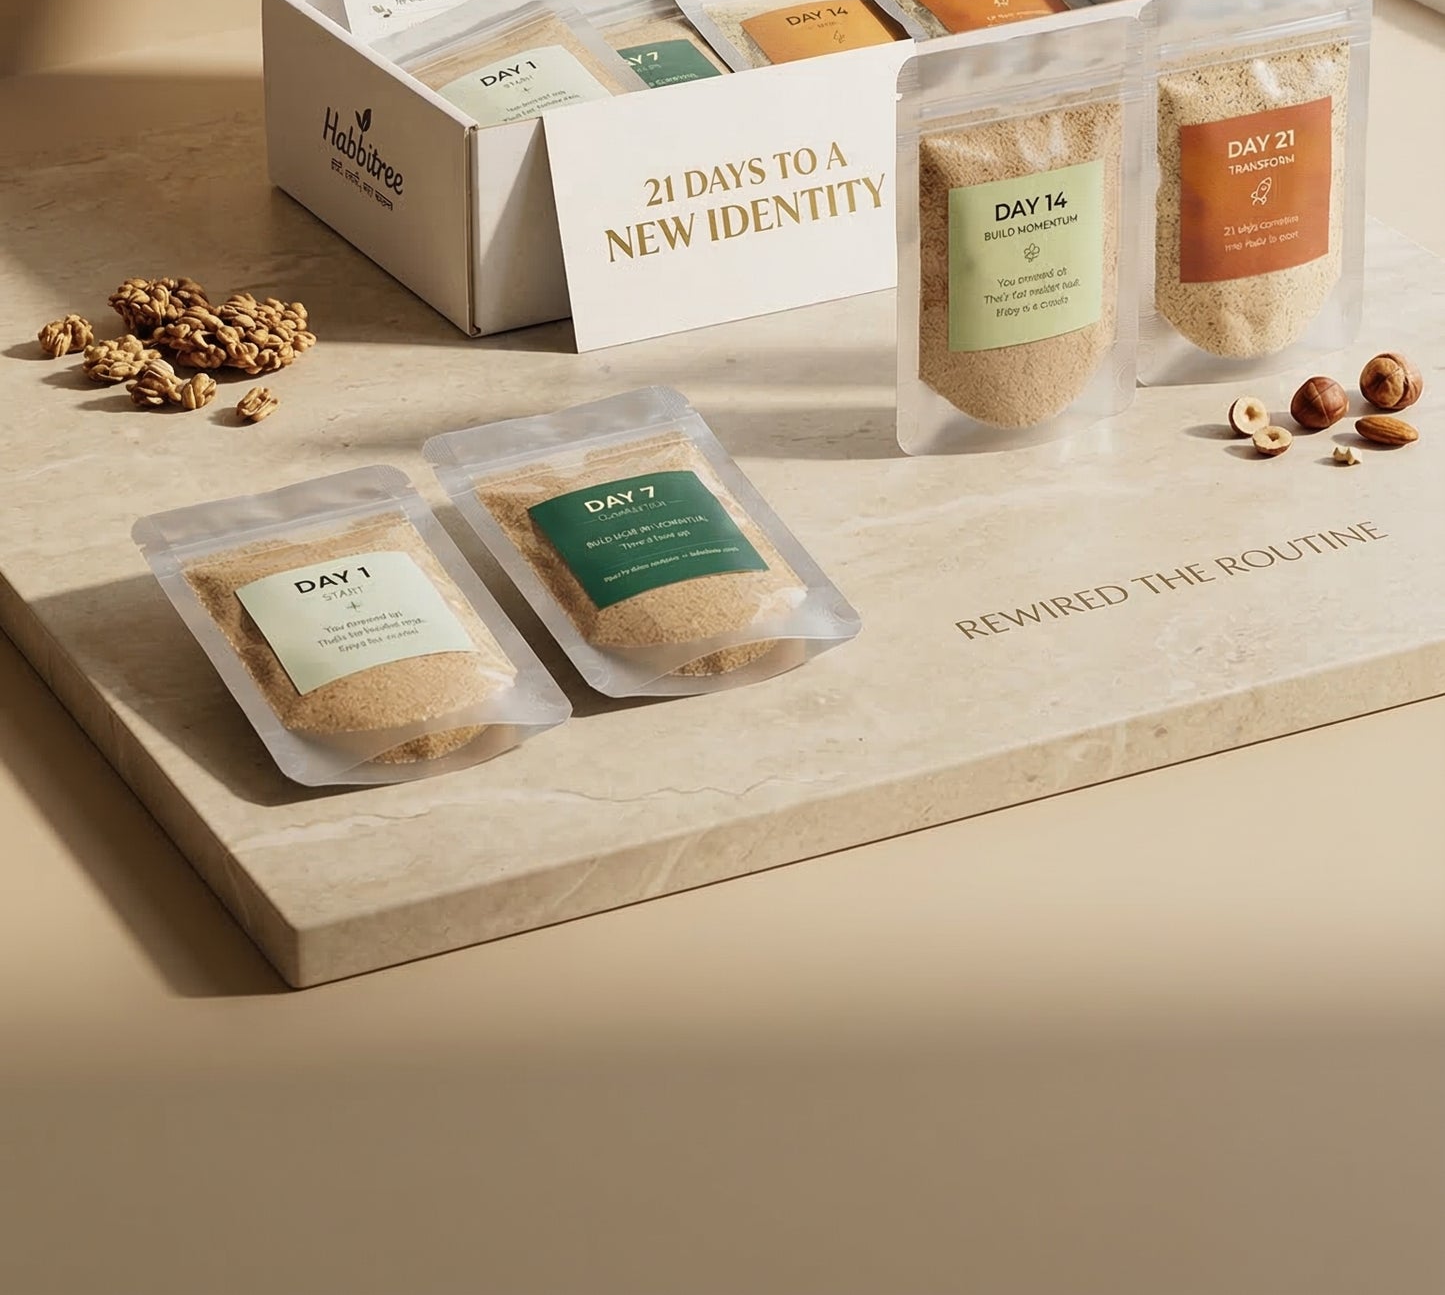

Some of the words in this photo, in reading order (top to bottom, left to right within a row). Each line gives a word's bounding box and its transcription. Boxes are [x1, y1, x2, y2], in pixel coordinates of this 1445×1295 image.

[786, 11, 821, 25] DAY
[827, 7, 848, 16] 14
[480, 65, 520, 86] DAY
[526, 61, 536, 69] 1
[323, 107, 403, 195] Habbitree
[1228, 134, 1270, 159] DAY
[1275, 129, 1295, 149] 21
[643, 175, 675, 207] 21
[684, 157, 766, 199] DAYS
[772, 148, 818, 179] TO
[826, 142, 847, 170] A
[605, 213, 695, 263] NEW
[707, 173, 885, 241] IDENTITY
[995, 196, 1040, 222] DAY
[1045, 191, 1067, 211] 14
[984, 228, 1015, 241] BUILD
[1017, 214, 1077, 235] MOMENTUM
[584, 490, 634, 513] DAY
[639, 486, 655, 498] 7
[294, 570, 349, 594] DAY
[357, 566, 371, 578] 1
[954, 585, 1130, 640] REWIRED
[1130, 563, 1216, 595] THE
[1214, 521, 1389, 576] ROUTINE
